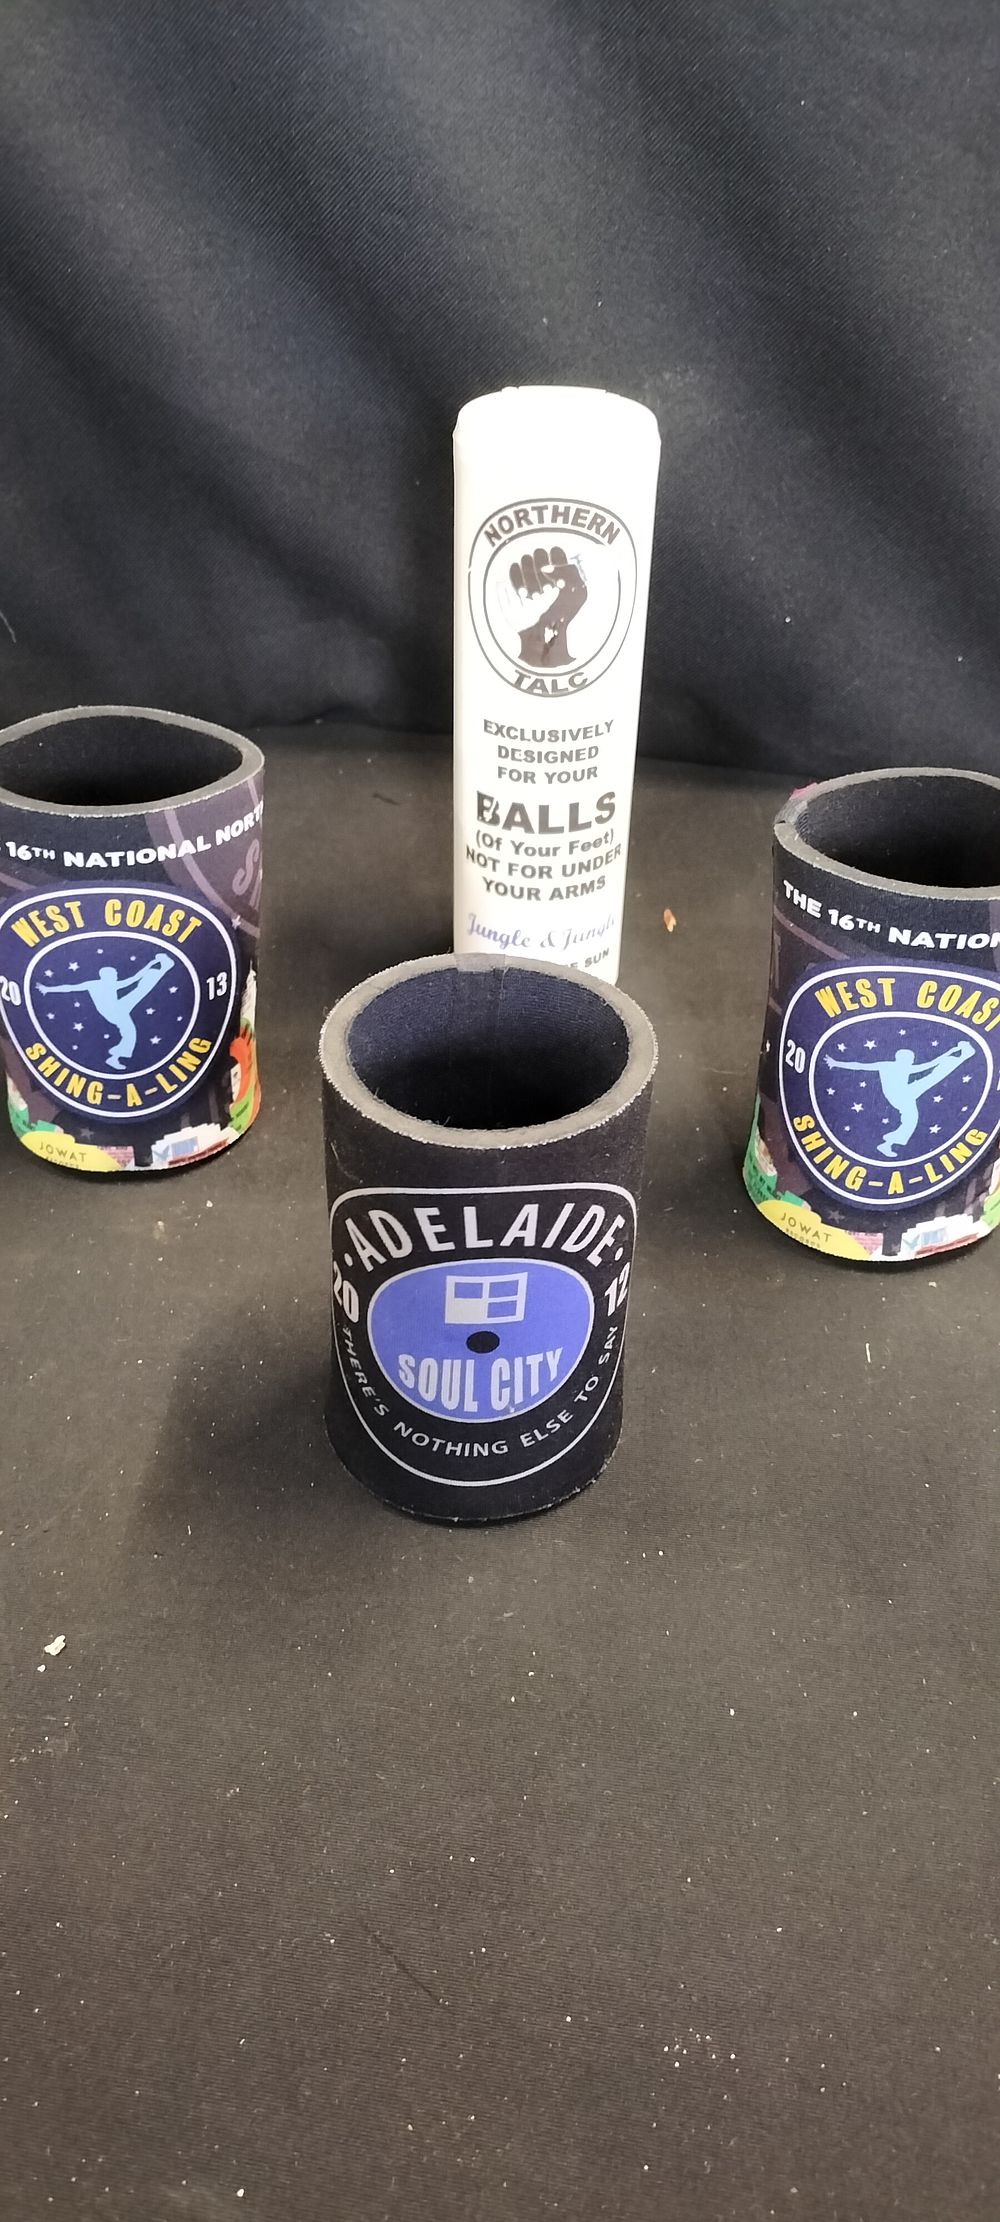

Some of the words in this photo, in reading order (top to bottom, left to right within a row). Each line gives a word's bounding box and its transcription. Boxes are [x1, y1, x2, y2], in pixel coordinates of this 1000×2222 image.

[484, 504, 620, 548] NORTHERN
[513, 669, 588, 695] TALC
[483, 719, 614, 742] EXCLUSIVELY
[498, 745, 599, 764] DESIGNED
[497, 766, 536, 784] FOR
[544, 766, 598, 784] YOUR
[476, 791, 616, 835] BALLS
[5, 841, 56, 861] 16TH
[63, 836, 212, 868] NATIONAL
[466, 845, 500, 872] NOT
[508, 862, 553, 879] FOR
[561, 844, 622, 878] UNDER
[475, 829, 502, 851] (Of
[510, 839, 560, 858] Your
[569, 828, 614, 852] Feet)
[482, 876, 541, 901] YOUR
[549, 875, 606, 901] ARMS
[782, 879, 822, 919] THE
[827, 908, 881, 934] 16TH
[11, 900, 85, 948] WEST
[104, 898, 202, 945] COAST
[468, 912, 531, 950] Jungle
[584, 947, 610, 968] SUN
[206, 971, 228, 1001] 13
[814, 977, 896, 1018] WEST
[25, 1036, 212, 1109] SHING-A-LING
[785, 1038, 805, 1075] 20
[39, 1141, 87, 1163] JOWAT
[793, 1113, 988, 1198] SHING-A-LING
[345, 1202, 626, 1273] ADELAIDE
[780, 1212, 832, 1243] JOWAT
[333, 1260, 360, 1324] 20
[605, 1261, 630, 1317] 12
[342, 1324, 390, 1417] THERE'S
[394, 1421, 508, 1457] NOTHING
[520, 1408, 573, 1448] ELSE
[574, 1374, 599, 1404] TO
[598, 1325, 618, 1365] SAY
[398, 1353, 478, 1413] SOUL
[490, 1347, 563, 1412] CITY
